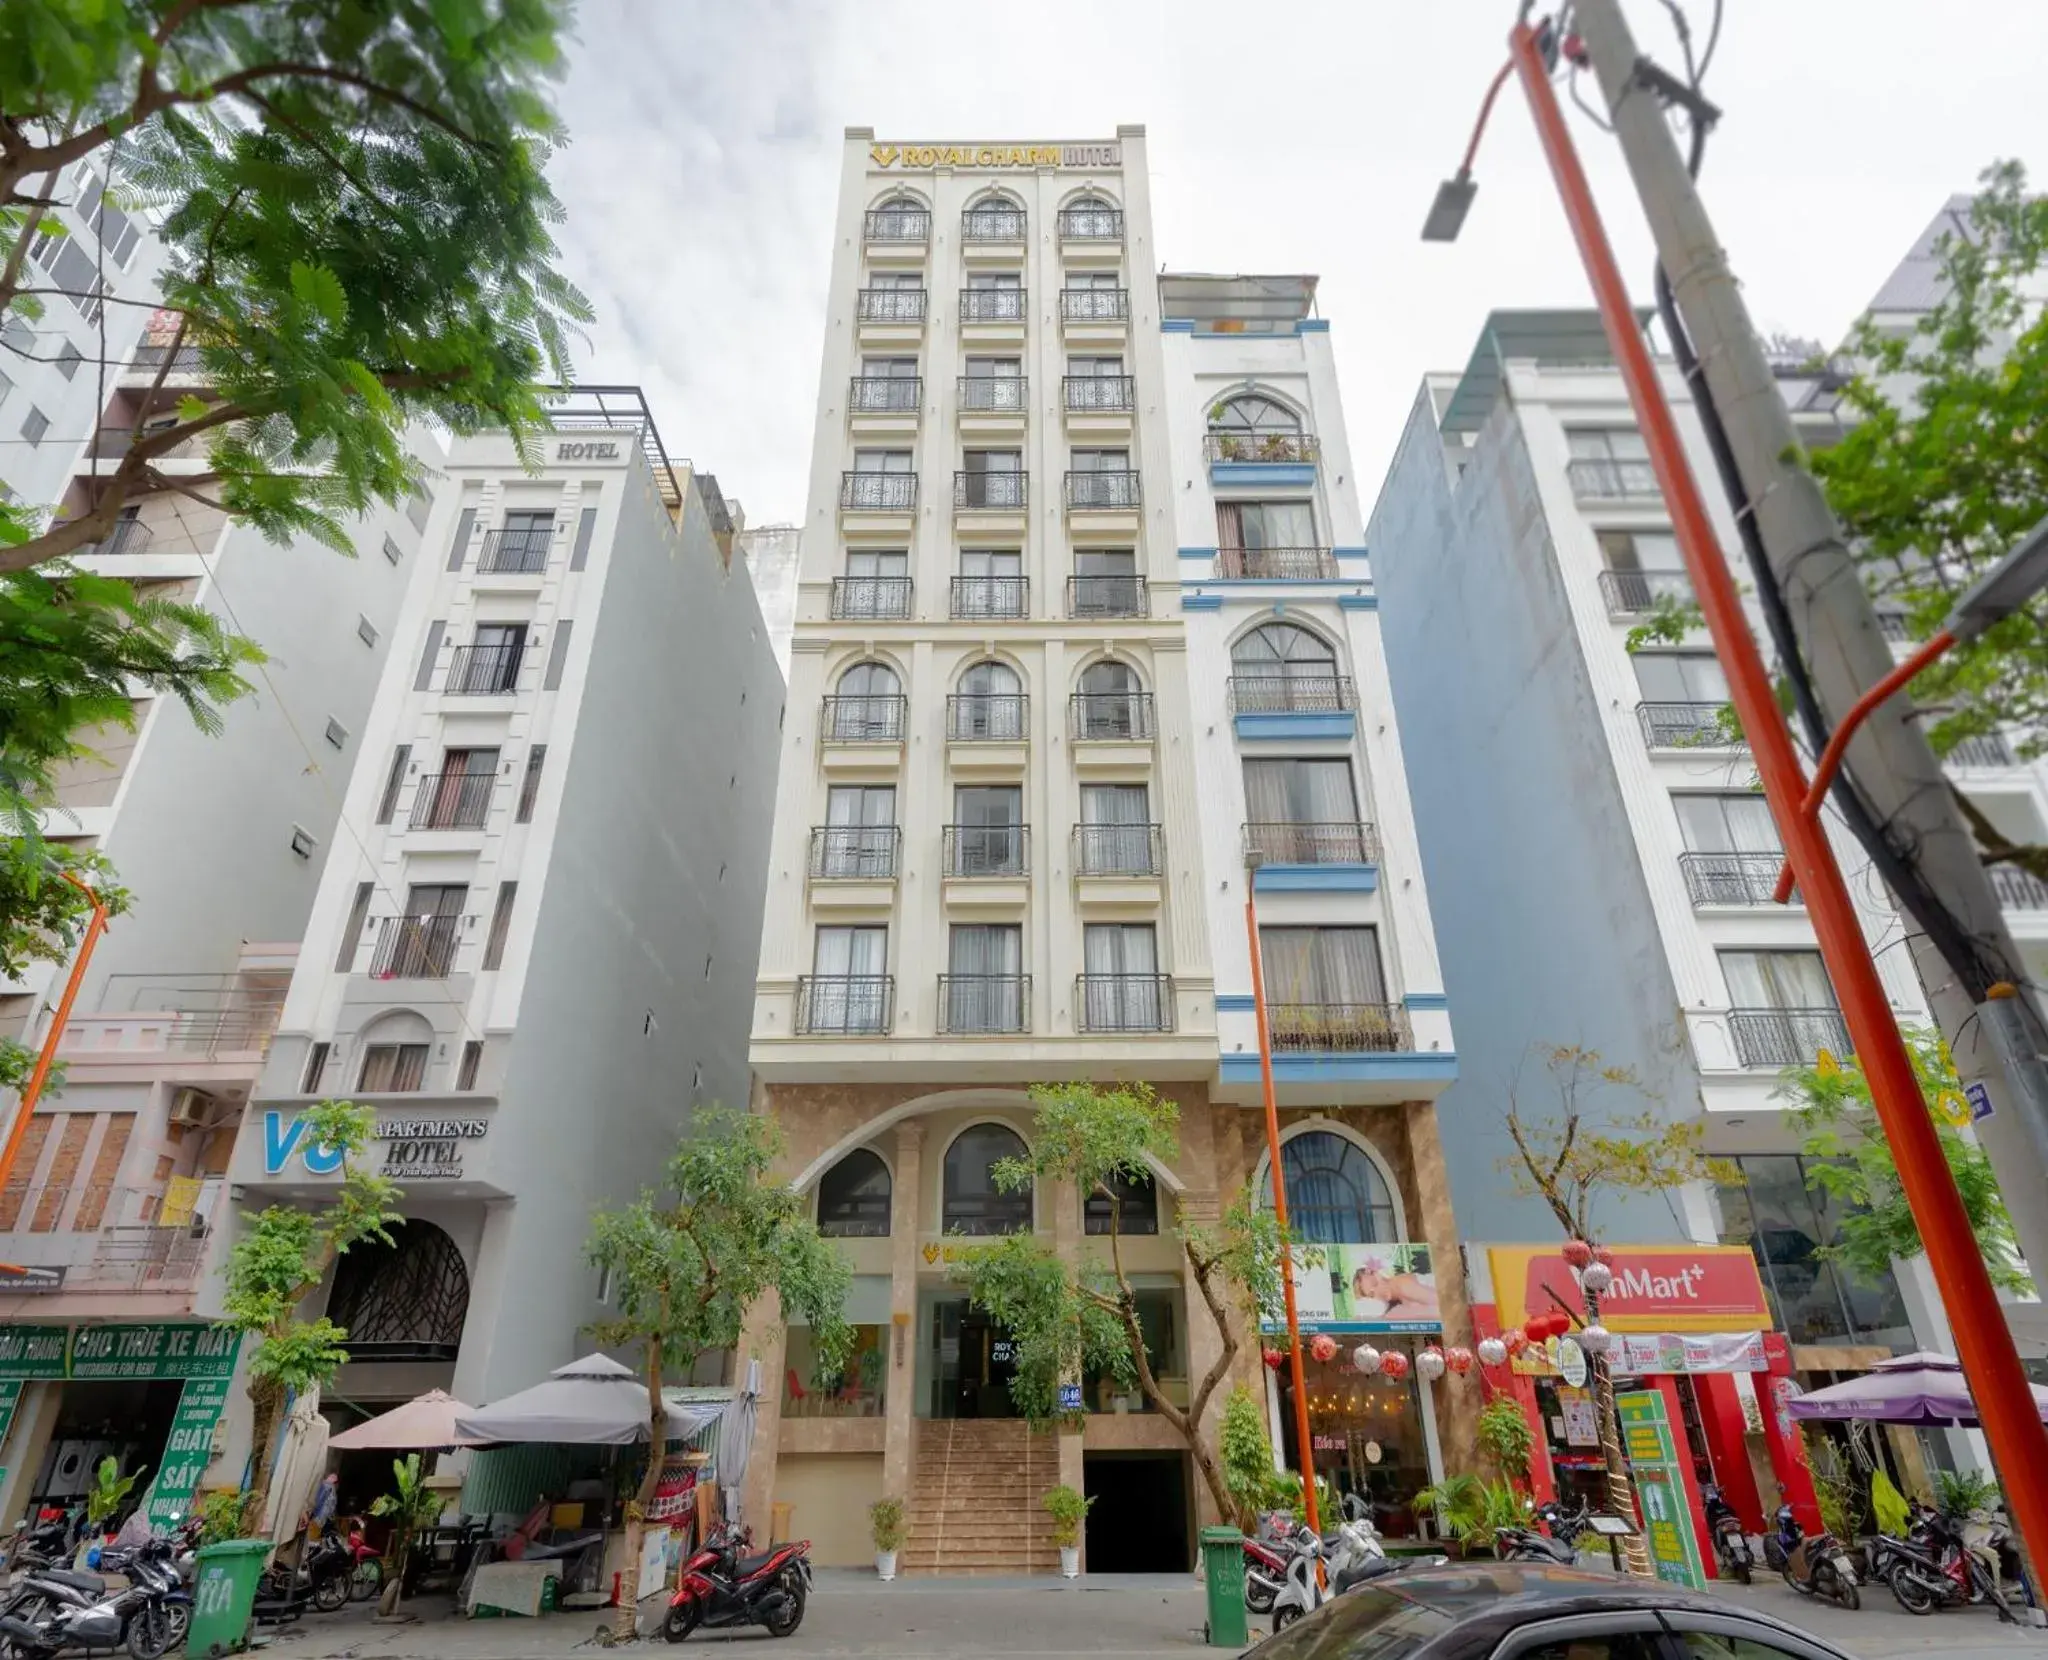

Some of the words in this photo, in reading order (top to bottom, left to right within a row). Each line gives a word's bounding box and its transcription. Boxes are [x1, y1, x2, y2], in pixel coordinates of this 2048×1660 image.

[901, 146, 976, 168] ROYAL
[976, 146, 1060, 167] CHARM
[1063, 147, 1122, 167] HOTEL
[557, 443, 619, 459] HOTEL
[384, 1141, 462, 1164] HOTEL
[1569, 1263, 1705, 1299] nMart+
[73, 1331, 114, 1358] CHO
[116, 1327, 164, 1358] THUÊ
[164, 1330, 194, 1357] XE
[171, 1425, 213, 1456] GIẶT
[162, 1458, 201, 1489] SẤY
